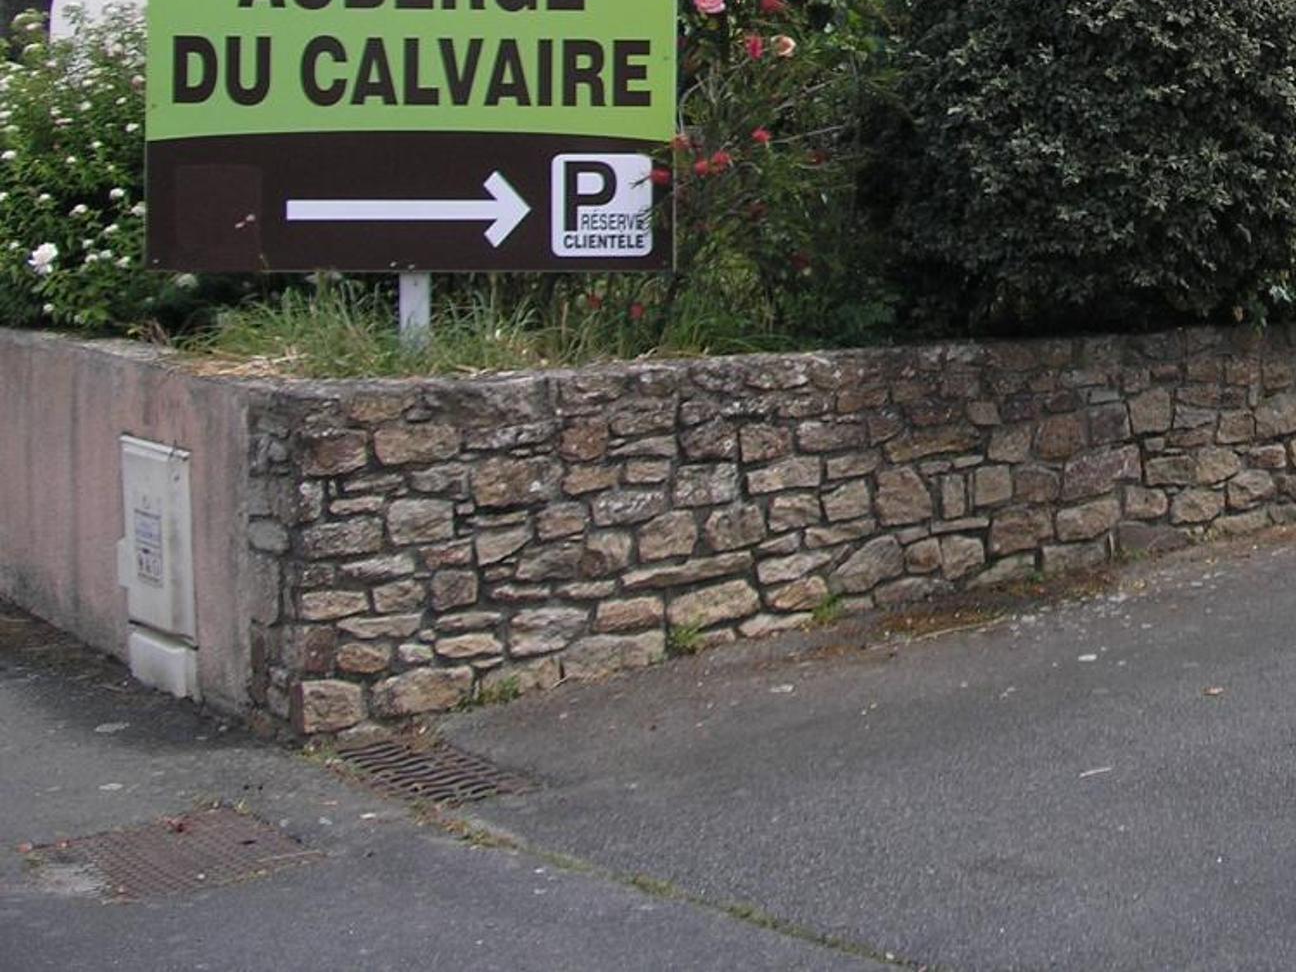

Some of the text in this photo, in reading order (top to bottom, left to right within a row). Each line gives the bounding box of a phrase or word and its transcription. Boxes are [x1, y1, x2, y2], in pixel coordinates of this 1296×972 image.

[172, 35, 653, 107] DU CALVAIRE
[563, 160, 617, 232] P
